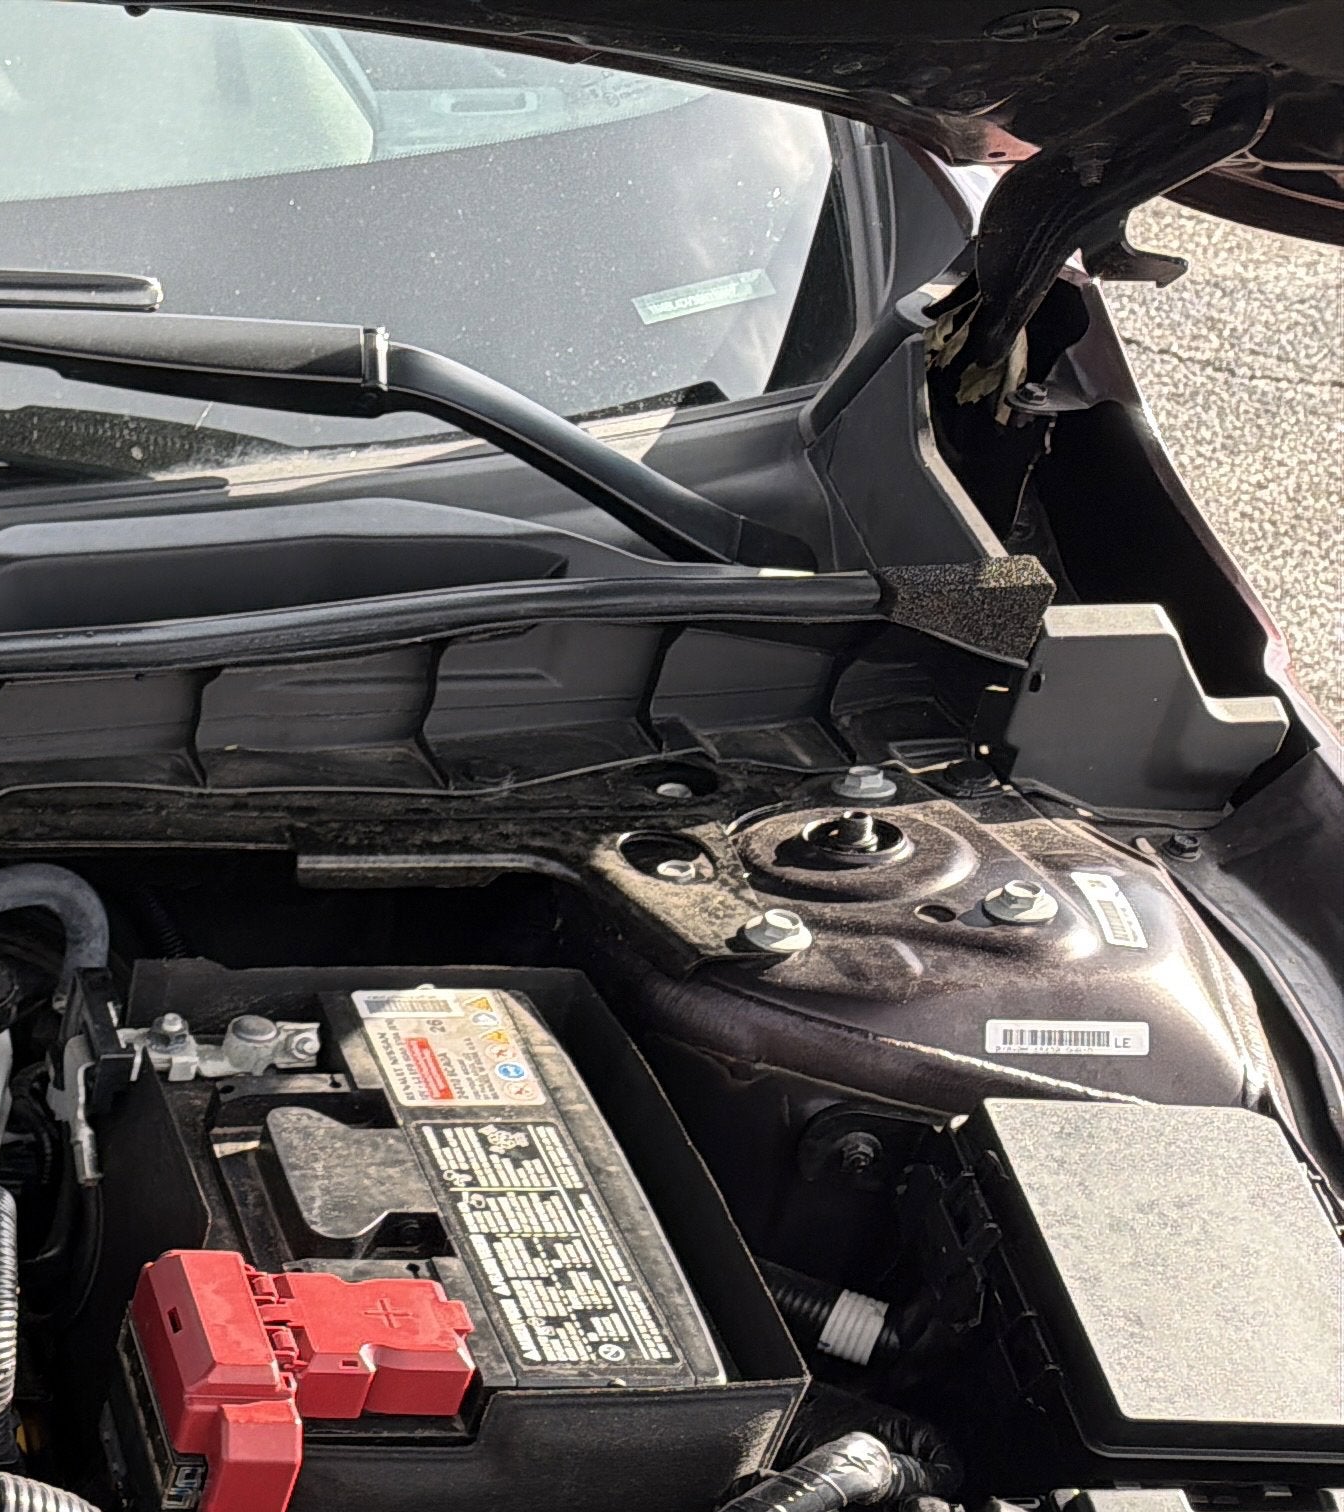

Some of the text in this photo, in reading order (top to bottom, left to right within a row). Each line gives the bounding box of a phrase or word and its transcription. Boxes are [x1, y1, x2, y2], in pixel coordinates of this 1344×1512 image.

[426, 1018, 446, 1033] 26
[376, 1031, 399, 1065] NISSAN
[1114, 1037, 1132, 1049] LE
